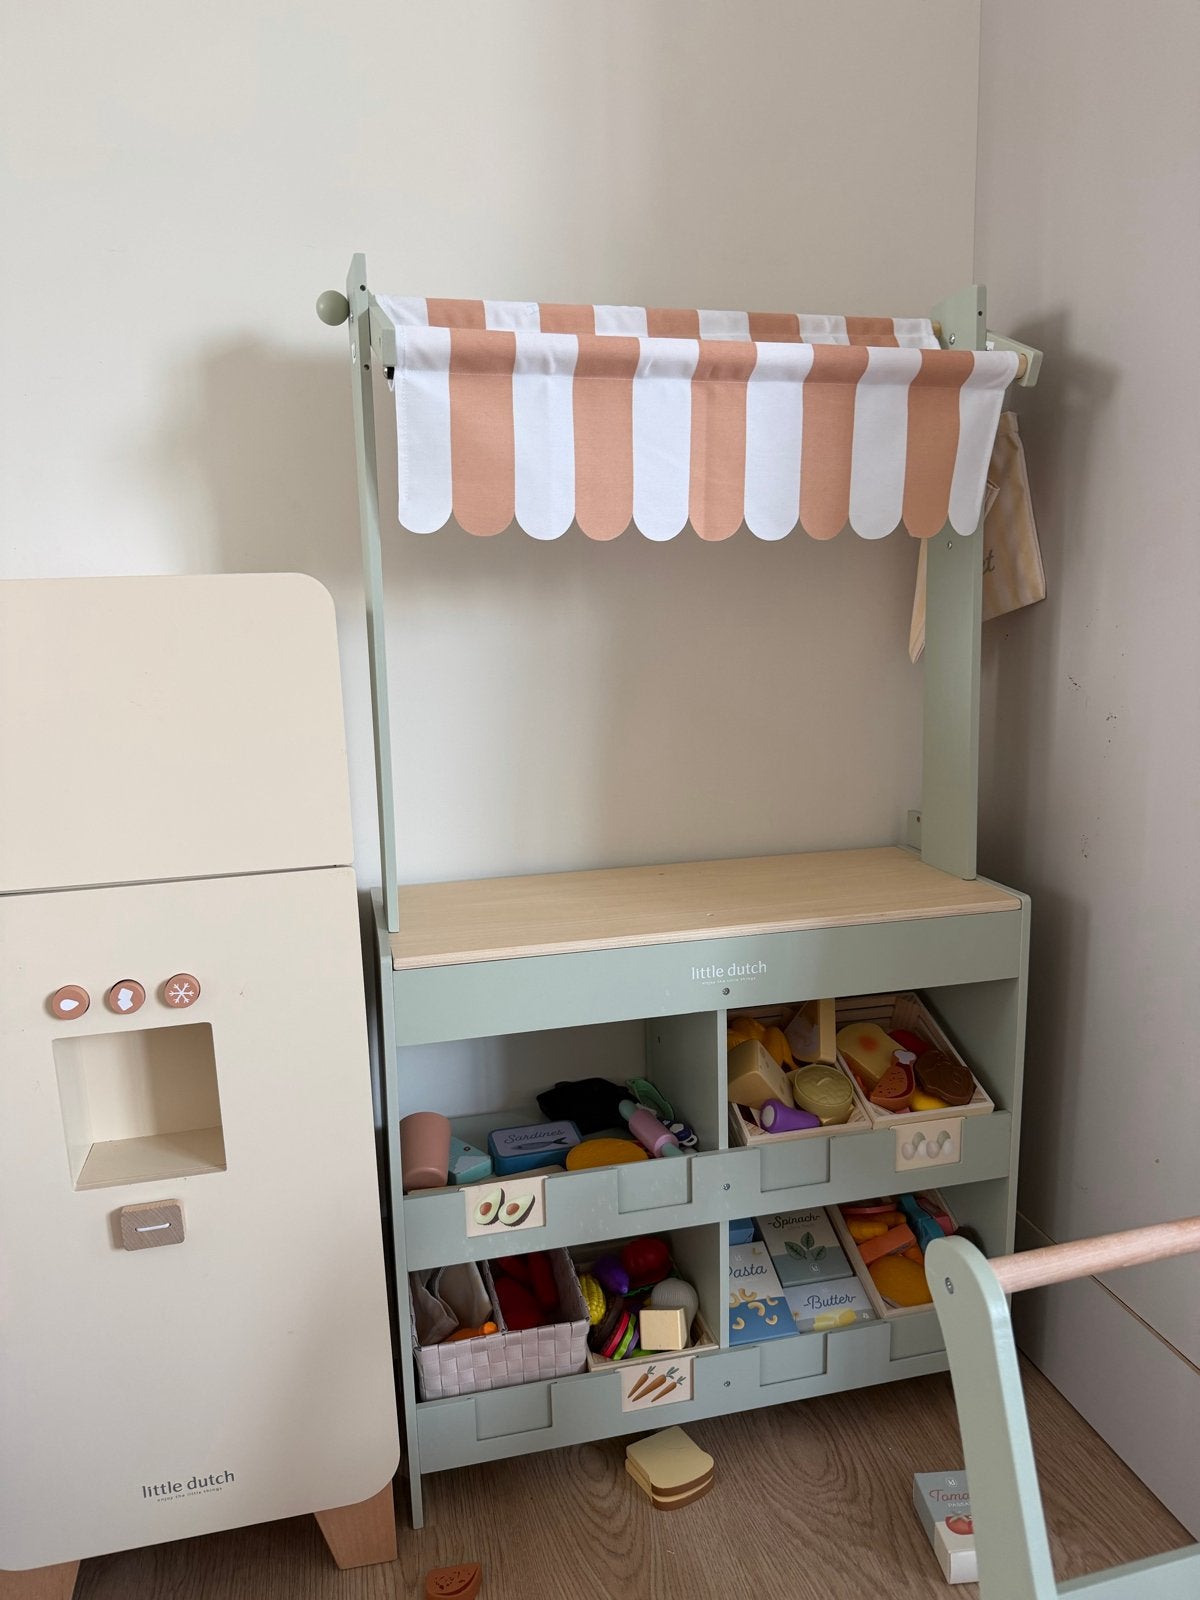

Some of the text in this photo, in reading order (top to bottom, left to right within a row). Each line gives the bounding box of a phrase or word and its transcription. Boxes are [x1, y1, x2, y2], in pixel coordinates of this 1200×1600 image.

[691, 960, 767, 980] little dutch
[504, 1129, 566, 1144] Sardines
[142, 1470, 235, 1499] little dutch
[929, 1489, 970, 1502] Toma
